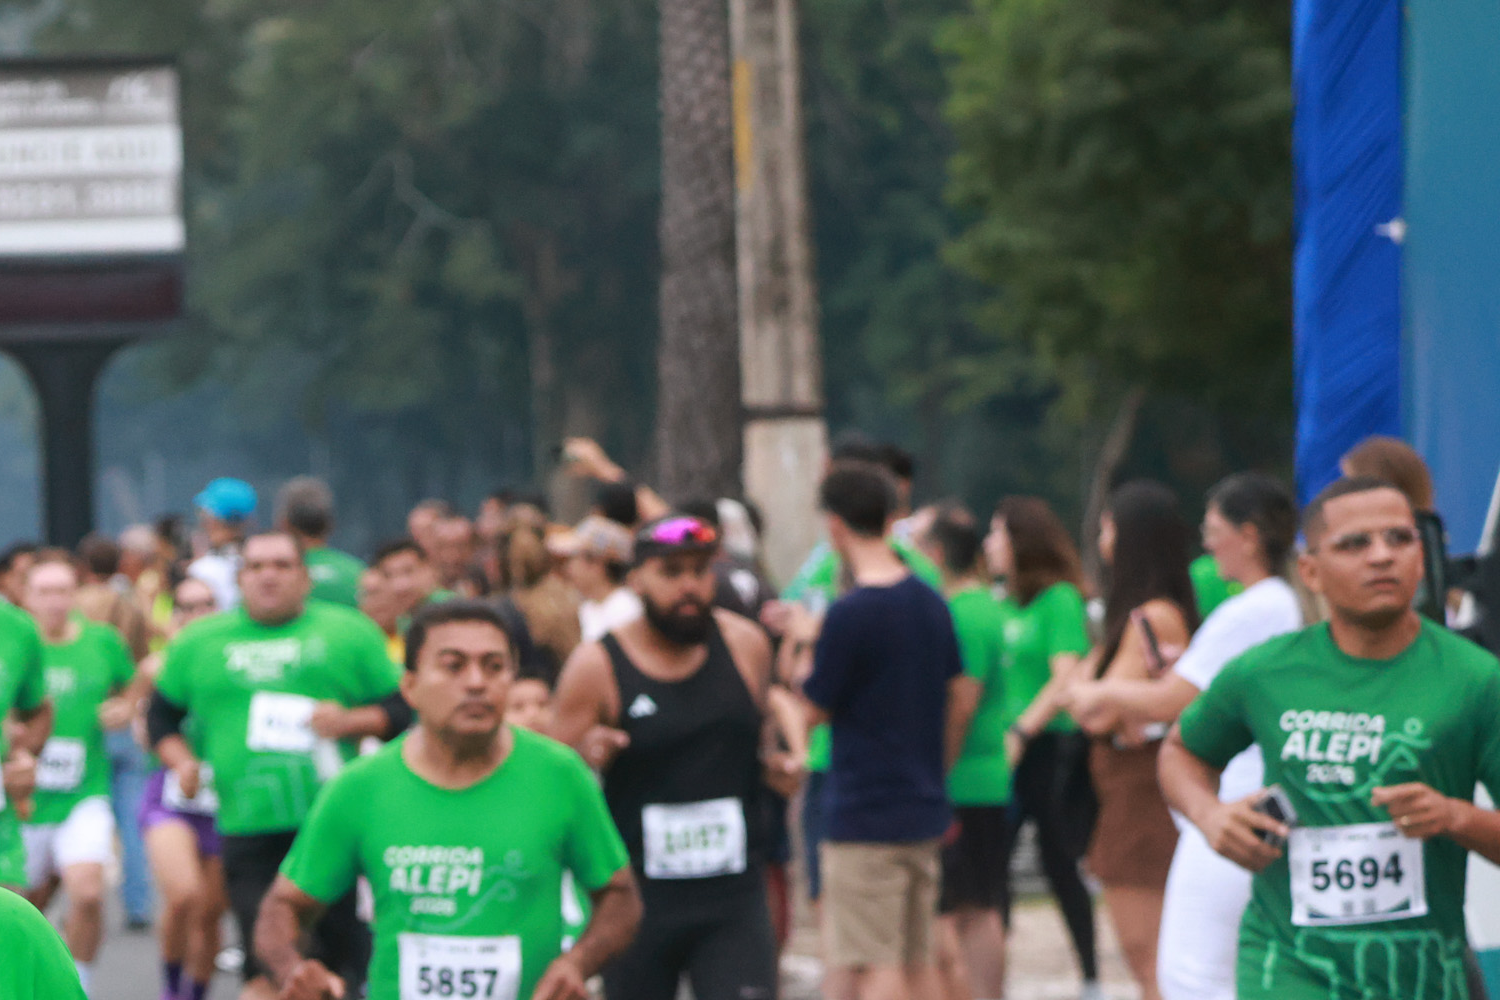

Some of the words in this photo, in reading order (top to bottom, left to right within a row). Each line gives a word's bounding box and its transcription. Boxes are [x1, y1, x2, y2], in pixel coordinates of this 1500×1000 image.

[1280, 710, 1384, 733] CORRIDA
[1281, 731, 1382, 764] ALEPI
[1306, 763, 1355, 785] 2026
[383, 846, 484, 868] CORRIDA
[1311, 852, 1404, 891] 5694
[389, 865, 483, 896] ALEPI
[418, 965, 499, 998] 5857
